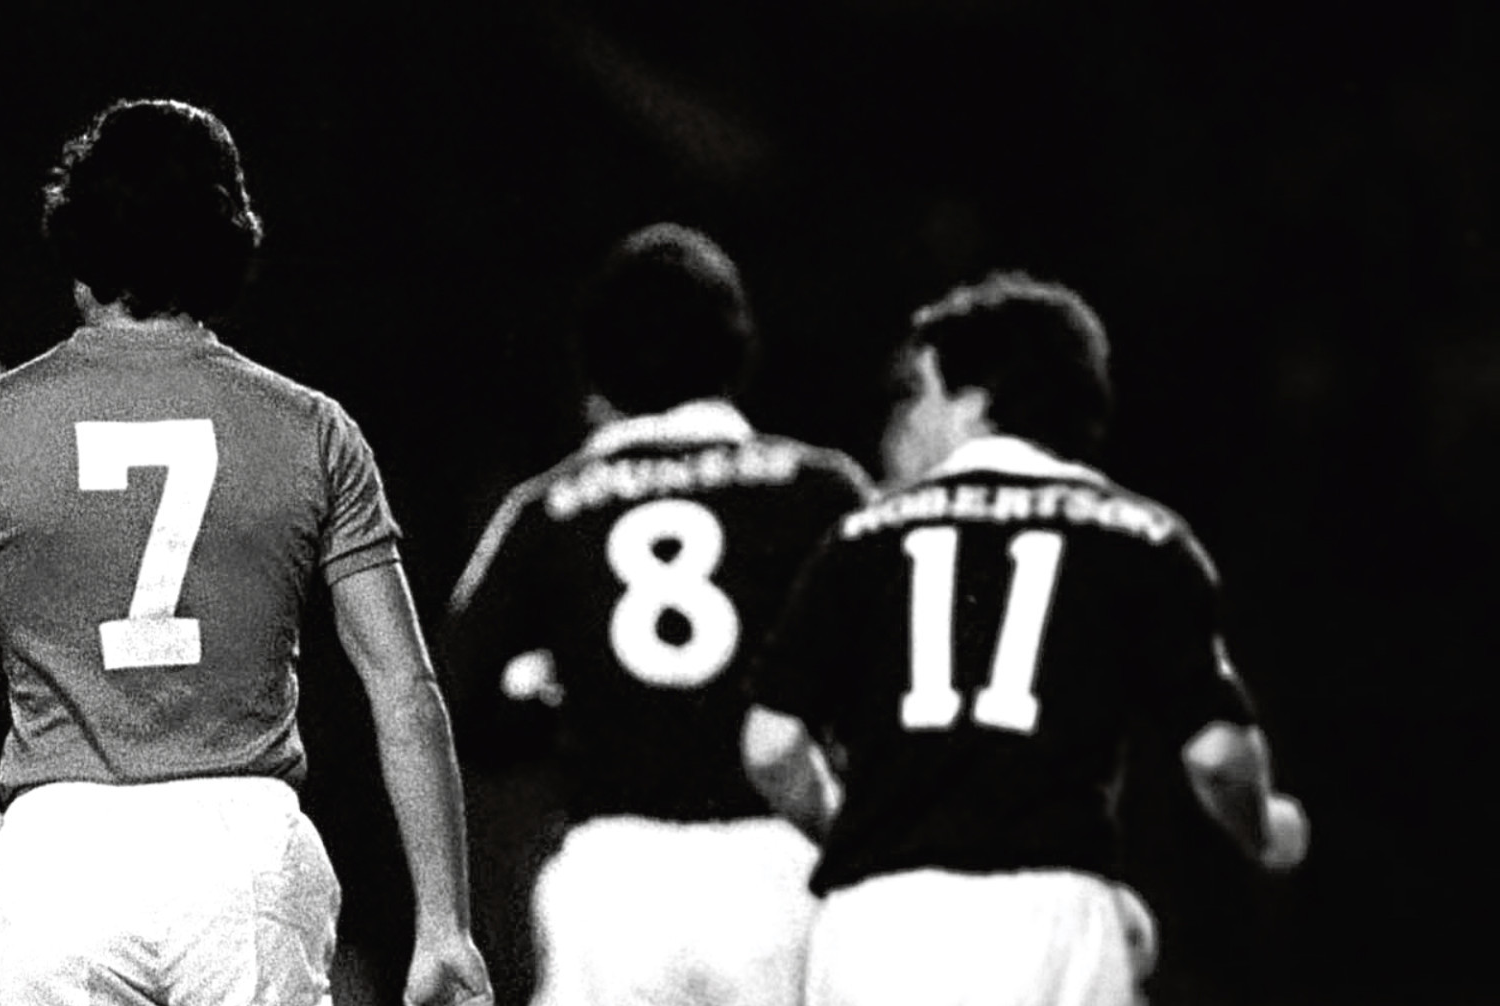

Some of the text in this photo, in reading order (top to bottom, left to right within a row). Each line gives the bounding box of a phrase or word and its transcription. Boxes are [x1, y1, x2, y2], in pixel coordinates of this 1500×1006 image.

[74, 418, 219, 671] 7
[606, 499, 741, 686] 8
[900, 526, 1065, 733] 11
